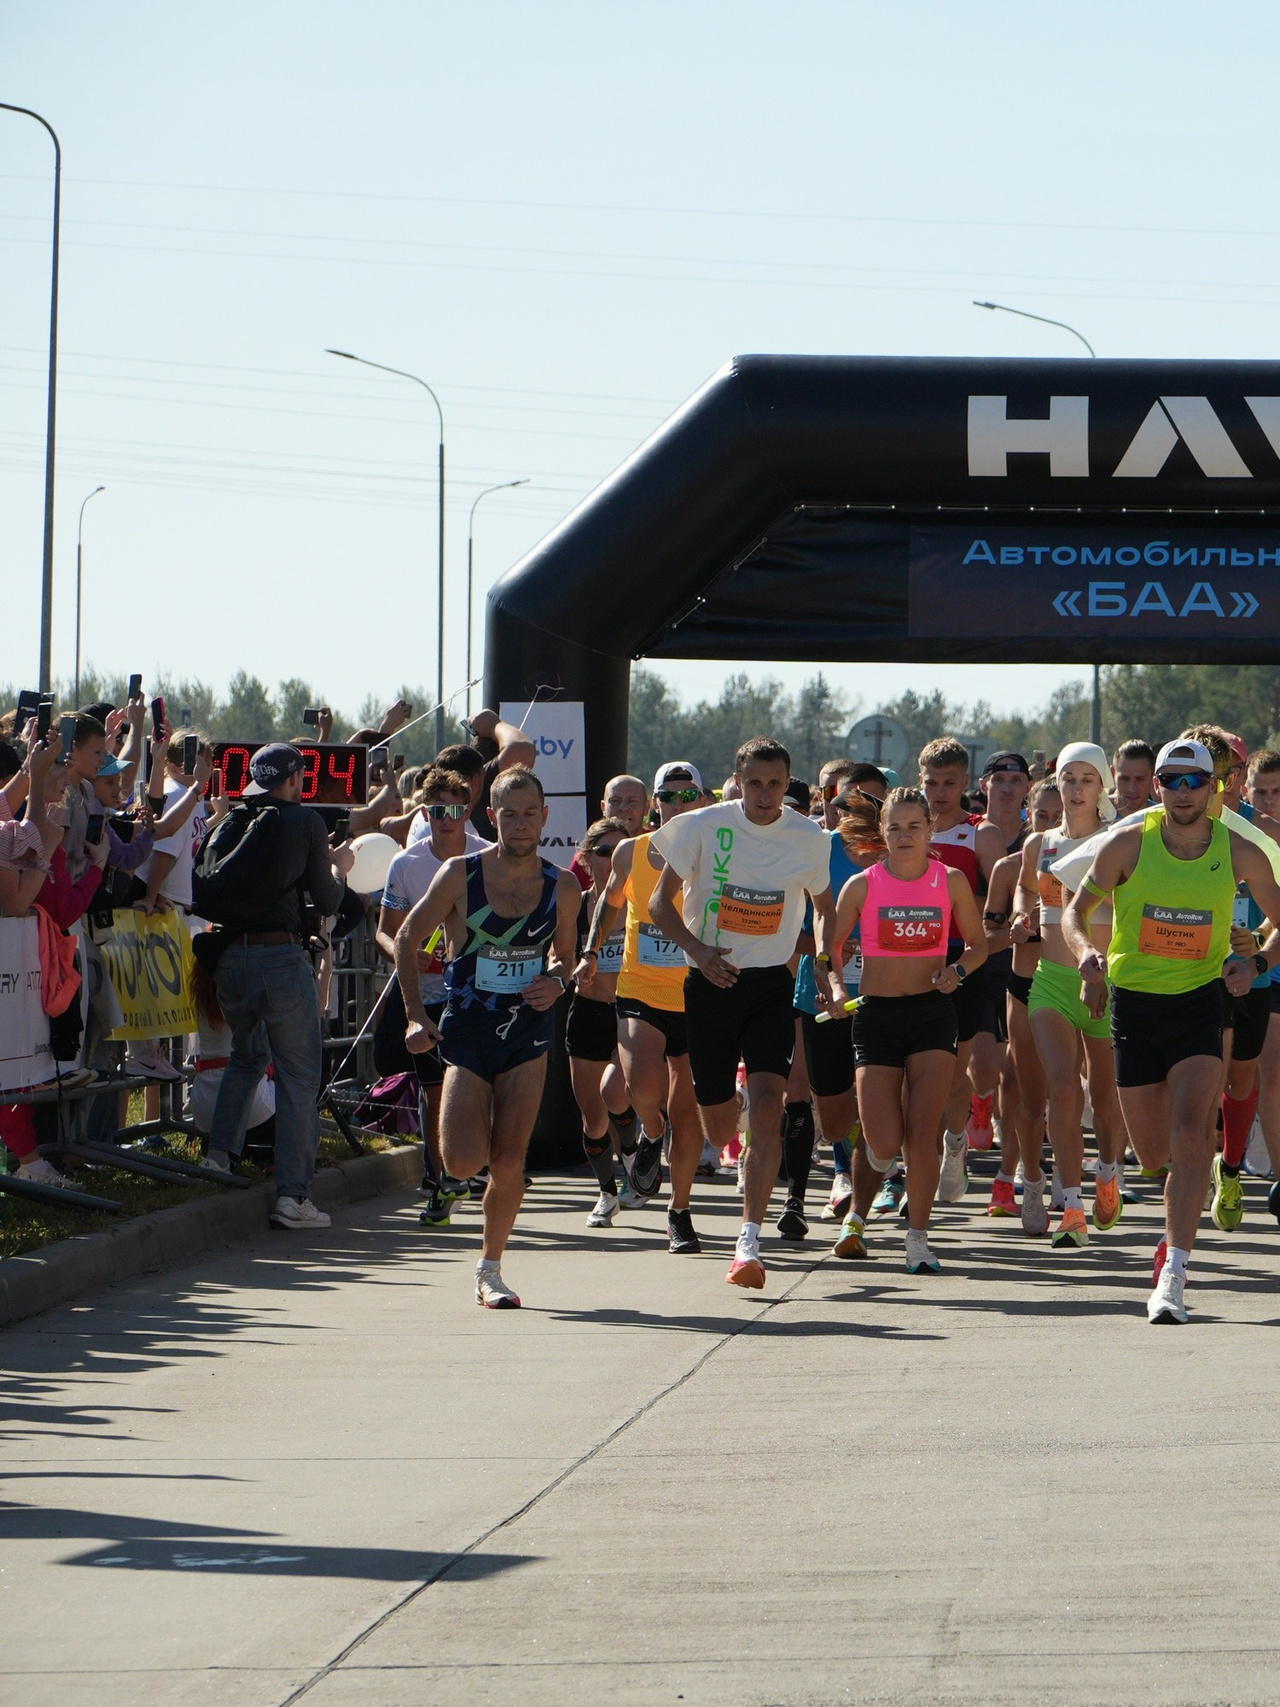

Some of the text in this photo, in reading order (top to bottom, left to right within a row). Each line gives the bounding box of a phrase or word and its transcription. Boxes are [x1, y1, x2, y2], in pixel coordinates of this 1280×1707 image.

[1051, 581, 1261, 618] «БАА»
[721, 901, 782, 917] Челядинский
[893, 922, 928, 937] 364
[1156, 926, 1196, 939] Шустик
[600, 945, 624, 959] 164
[496, 962, 525, 977] 211
